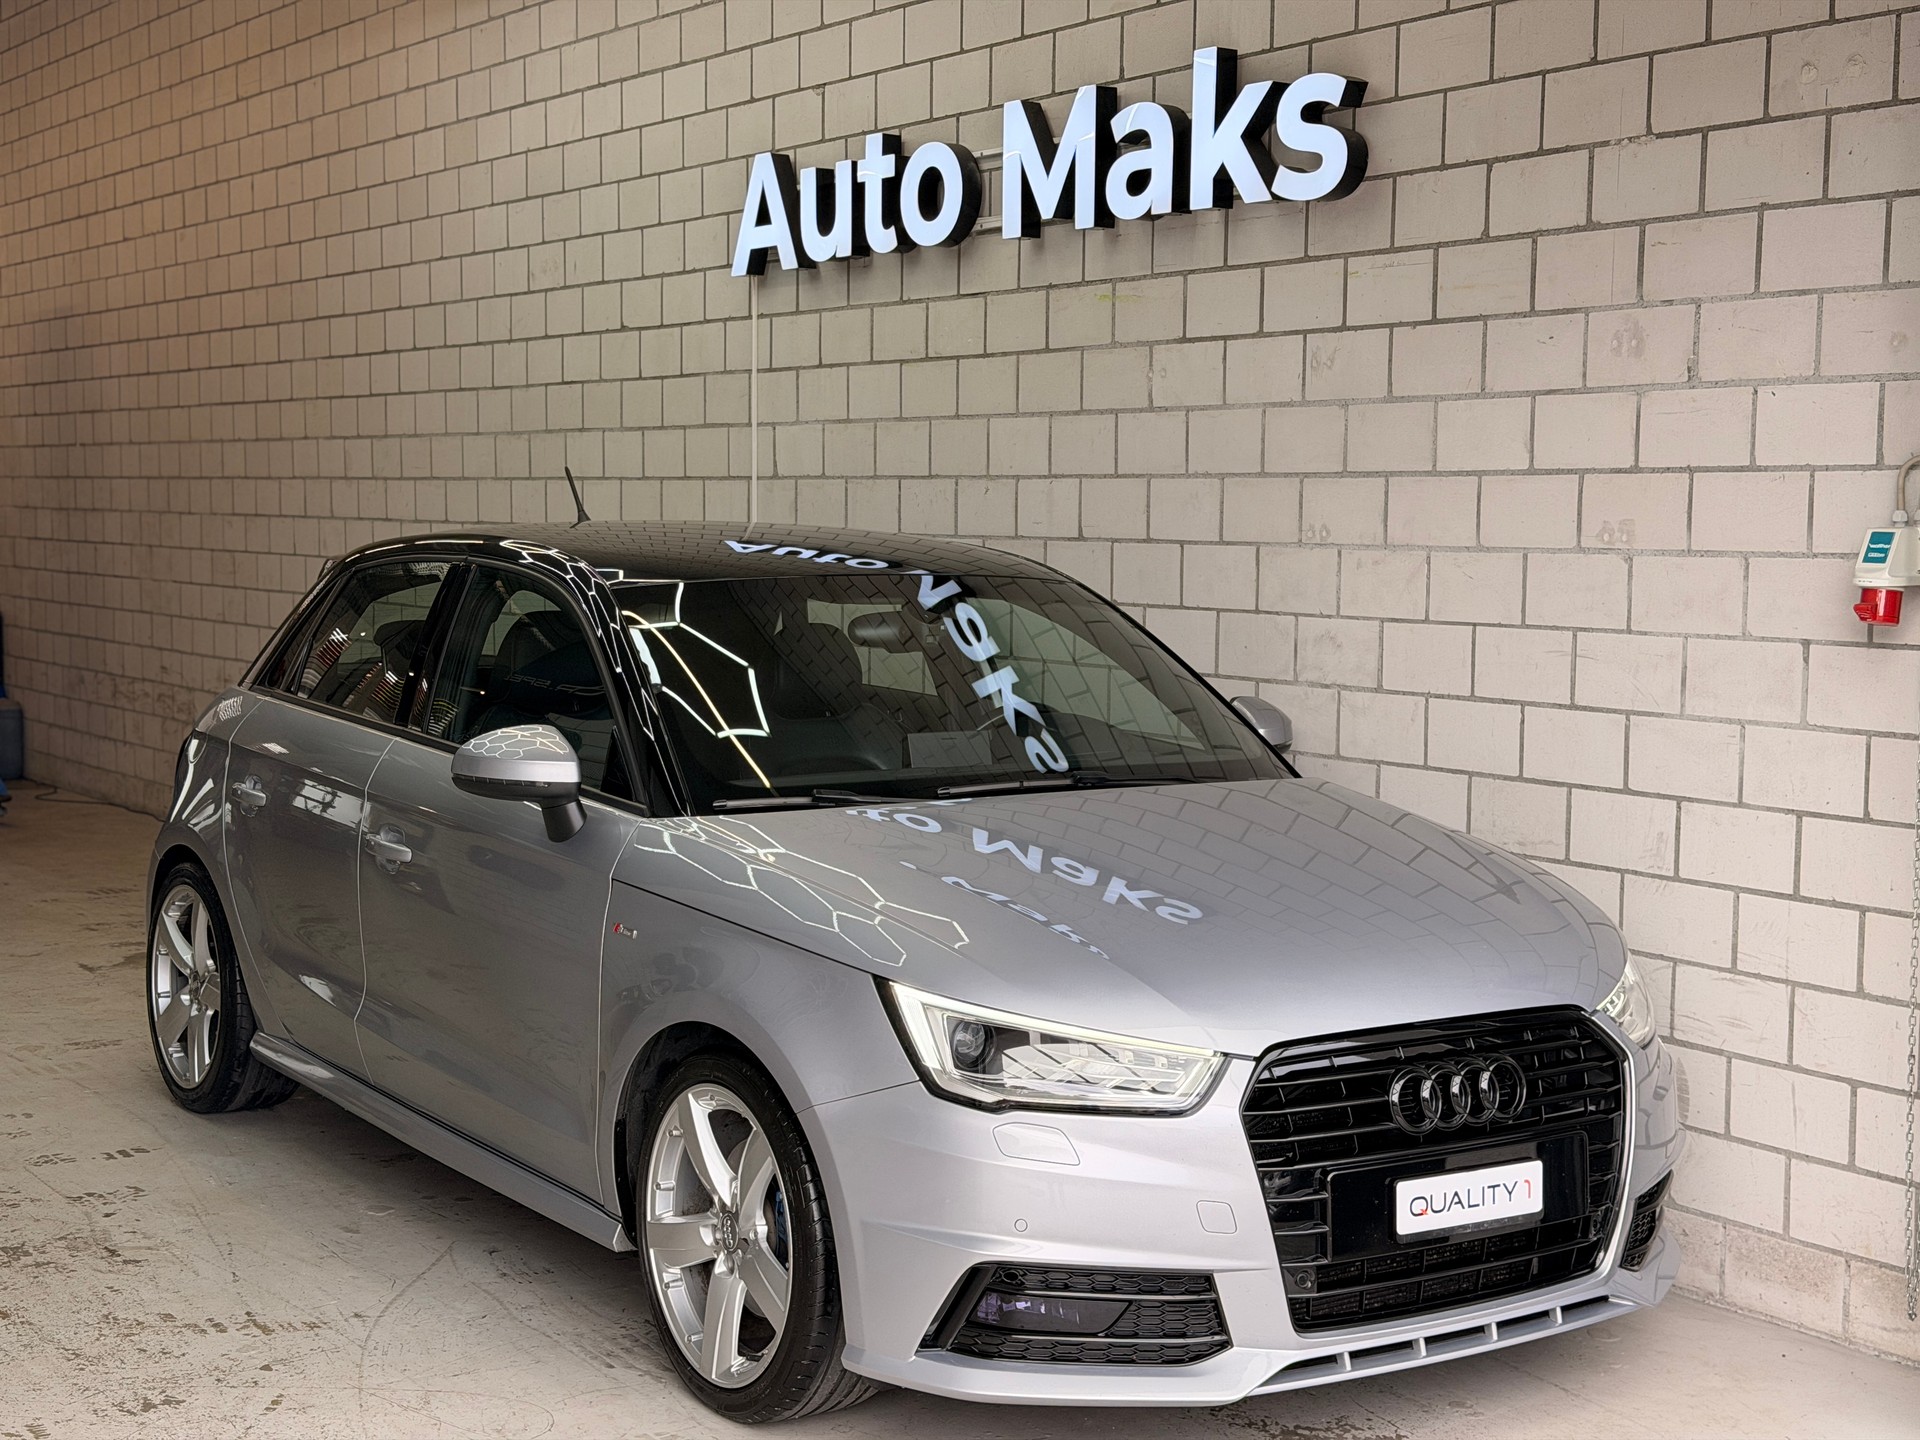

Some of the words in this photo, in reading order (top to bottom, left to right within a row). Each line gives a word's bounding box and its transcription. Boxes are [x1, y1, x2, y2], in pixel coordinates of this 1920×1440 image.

[731, 133, 966, 277] Auto
[1002, 46, 1357, 240] Maks
[1409, 1181, 1518, 1217] QUALITY
[1524, 1179, 1532, 1199] 1
